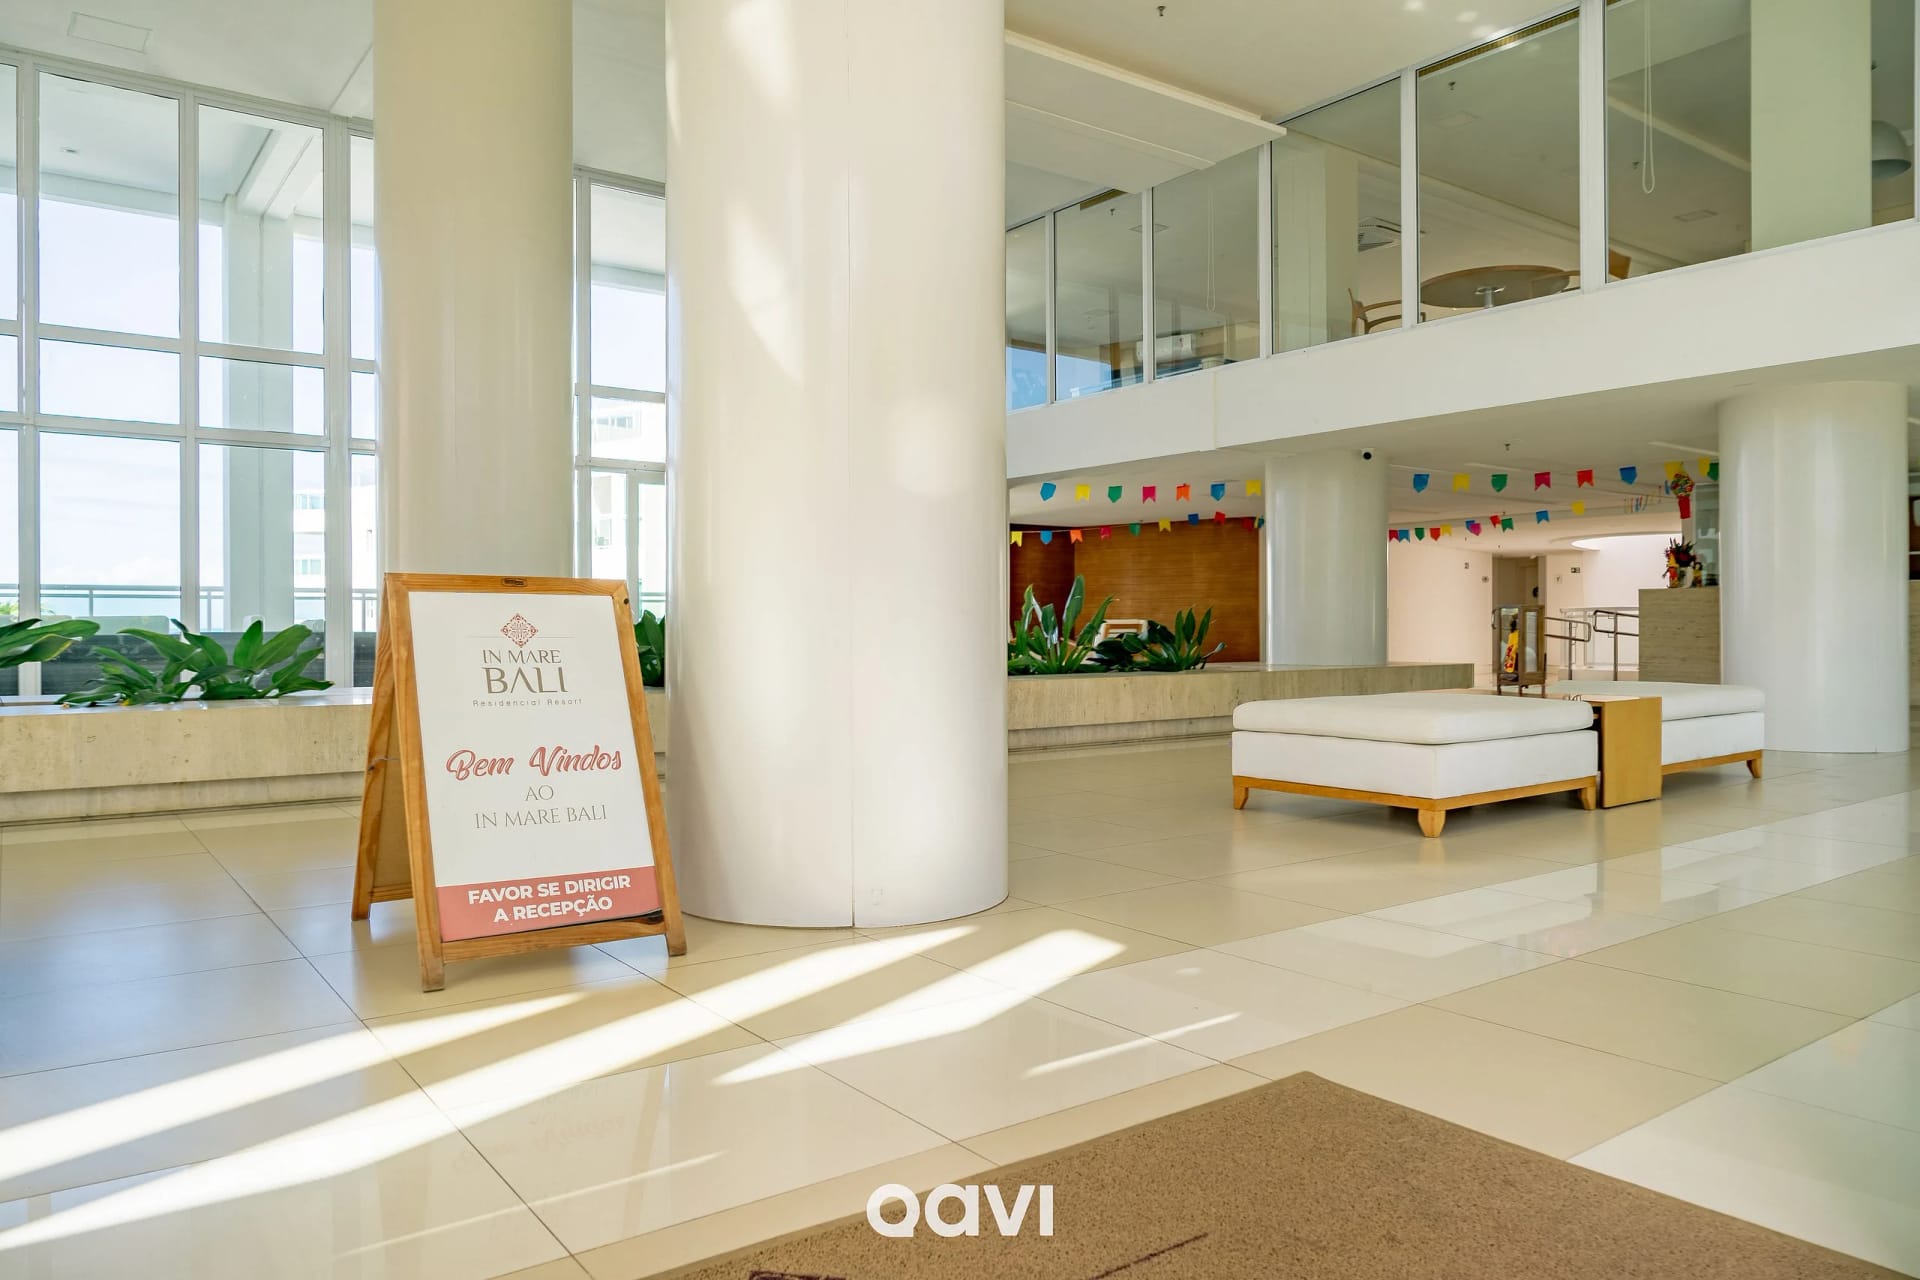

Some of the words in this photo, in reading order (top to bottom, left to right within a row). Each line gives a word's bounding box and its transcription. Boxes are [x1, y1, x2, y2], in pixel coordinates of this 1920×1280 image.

[482, 649, 502, 664] IN
[508, 649, 562, 664] MARE
[481, 666, 568, 694] BALI
[473, 699, 541, 708] Residencial
[547, 698, 582, 706] Resort
[445, 749, 515, 781] Bem
[529, 744, 622, 777] Vindos
[525, 785, 554, 801] AO
[475, 812, 498, 829] IN
[505, 808, 561, 828] MARE
[567, 804, 607, 823] BALI
[468, 885, 533, 905] FAVOR
[537, 882, 561, 898] SE
[564, 875, 632, 895] DIRIGIR
[493, 908, 510, 923] A
[513, 895, 613, 920] RECEPÇÃO
